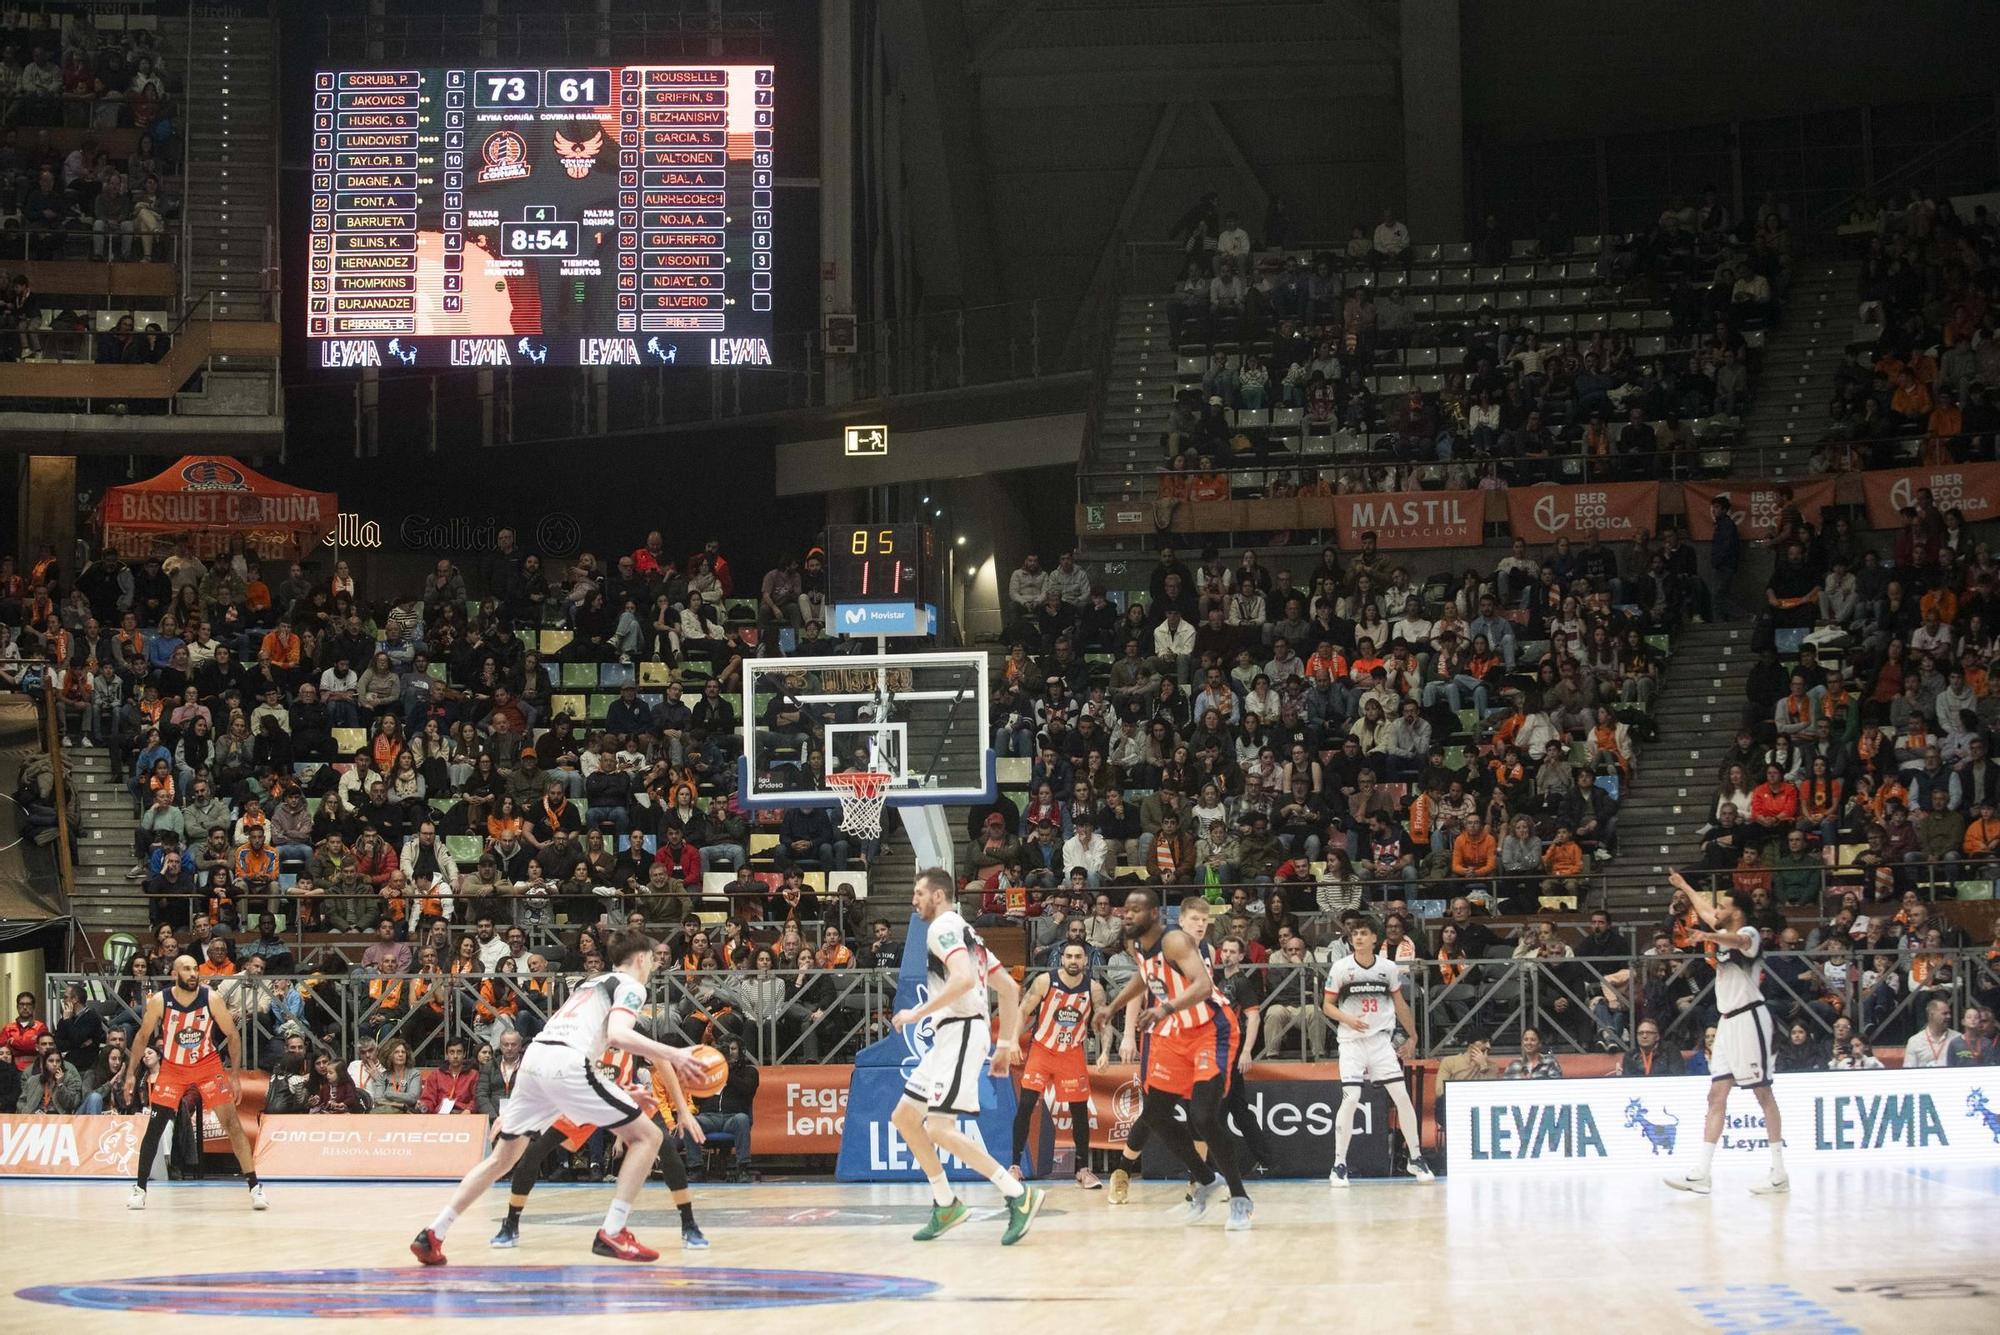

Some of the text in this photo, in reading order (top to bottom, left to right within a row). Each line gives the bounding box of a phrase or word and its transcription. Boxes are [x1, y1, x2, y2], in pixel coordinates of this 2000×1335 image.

[349, 76, 396, 85] SCRUBB,
[400, 76, 408, 84] P.
[452, 75, 459, 84] 8
[626, 73, 766, 82] 2 ROUSSELLE 7
[488, 77, 526, 101] 73
[560, 78, 594, 101] 61
[352, 96, 405, 105] JAKOVICS
[453, 96, 457, 104] 1
[627, 94, 633, 102] 4
[656, 93, 702, 103] GRIFFIN,
[760, 93, 765, 102] 7
[321, 115, 458, 126] 8 HUSKIC, G. 6
[626, 114, 632, 122] 9
[650, 113, 719, 122] BEZHANISHV
[320, 136, 457, 146] 9 LUNDQVIST 4
[624, 134, 635, 142] 10
[656, 134, 699, 143] GARCIA,
[349, 157, 392, 167] TAYLOR,
[448, 156, 460, 164] 10
[656, 154, 713, 163] VALTONEN
[756, 154, 768, 164] 15
[317, 178, 328, 186] 12
[348, 177, 391, 187] DIAGNE,
[450, 177, 457, 185] 5
[623, 175, 635, 183] 12
[759, 175, 765, 184] 6
[315, 197, 459, 207] 22 FONT, A. 11
[622, 195, 723, 204] 15 AURRECOECH
[536, 209, 545, 219] 4
[315, 217, 456, 227] 23 BARRUETA 8
[583, 218, 615, 226] EQUIPO
[623, 215, 767, 225] 17 NOJA, A. 11
[314, 238, 455, 248] 25 SILINS, K. 4
[511, 229, 568, 250] 8:54
[595, 233, 602, 244] 1
[622, 236, 634, 245] 32
[759, 236, 765, 244] 6
[314, 258, 408, 268] 30 HERNANDEZ
[622, 256, 765, 266] 33 VISCONTI 3
[561, 268, 601, 276] MUERTOS
[314, 279, 455, 289] 33 THOMPKINS 2
[621, 278, 633, 286] 46
[654, 277, 696, 287] NDIAYE,
[313, 299, 458, 309] 77 BURJANADZE 14
[621, 297, 708, 306] 51 SILVERIO
[315, 321, 321, 330] E
[321, 341, 381, 367] LEYMA
[451, 339, 511, 365] LEYMA
[580, 339, 641, 365] LEYMA
[711, 338, 772, 364] LEYMA
[1931, 474, 1963, 487] IBER
[1575, 492, 1608, 504] IBER
[1932, 487, 1962, 500] ECO
[122, 493, 221, 523] BASQUET
[1575, 505, 1606, 517] ECO
[1352, 500, 1467, 527] MASTIL
[871, 610, 905, 620] Movistar
[1362, 999, 1378, 1013] 33
[1815, 1093, 1949, 1150] LEYMA
[1471, 1103, 1607, 1160] LEYMA
[270, 1130, 470, 1144] OMODA JAECOO
